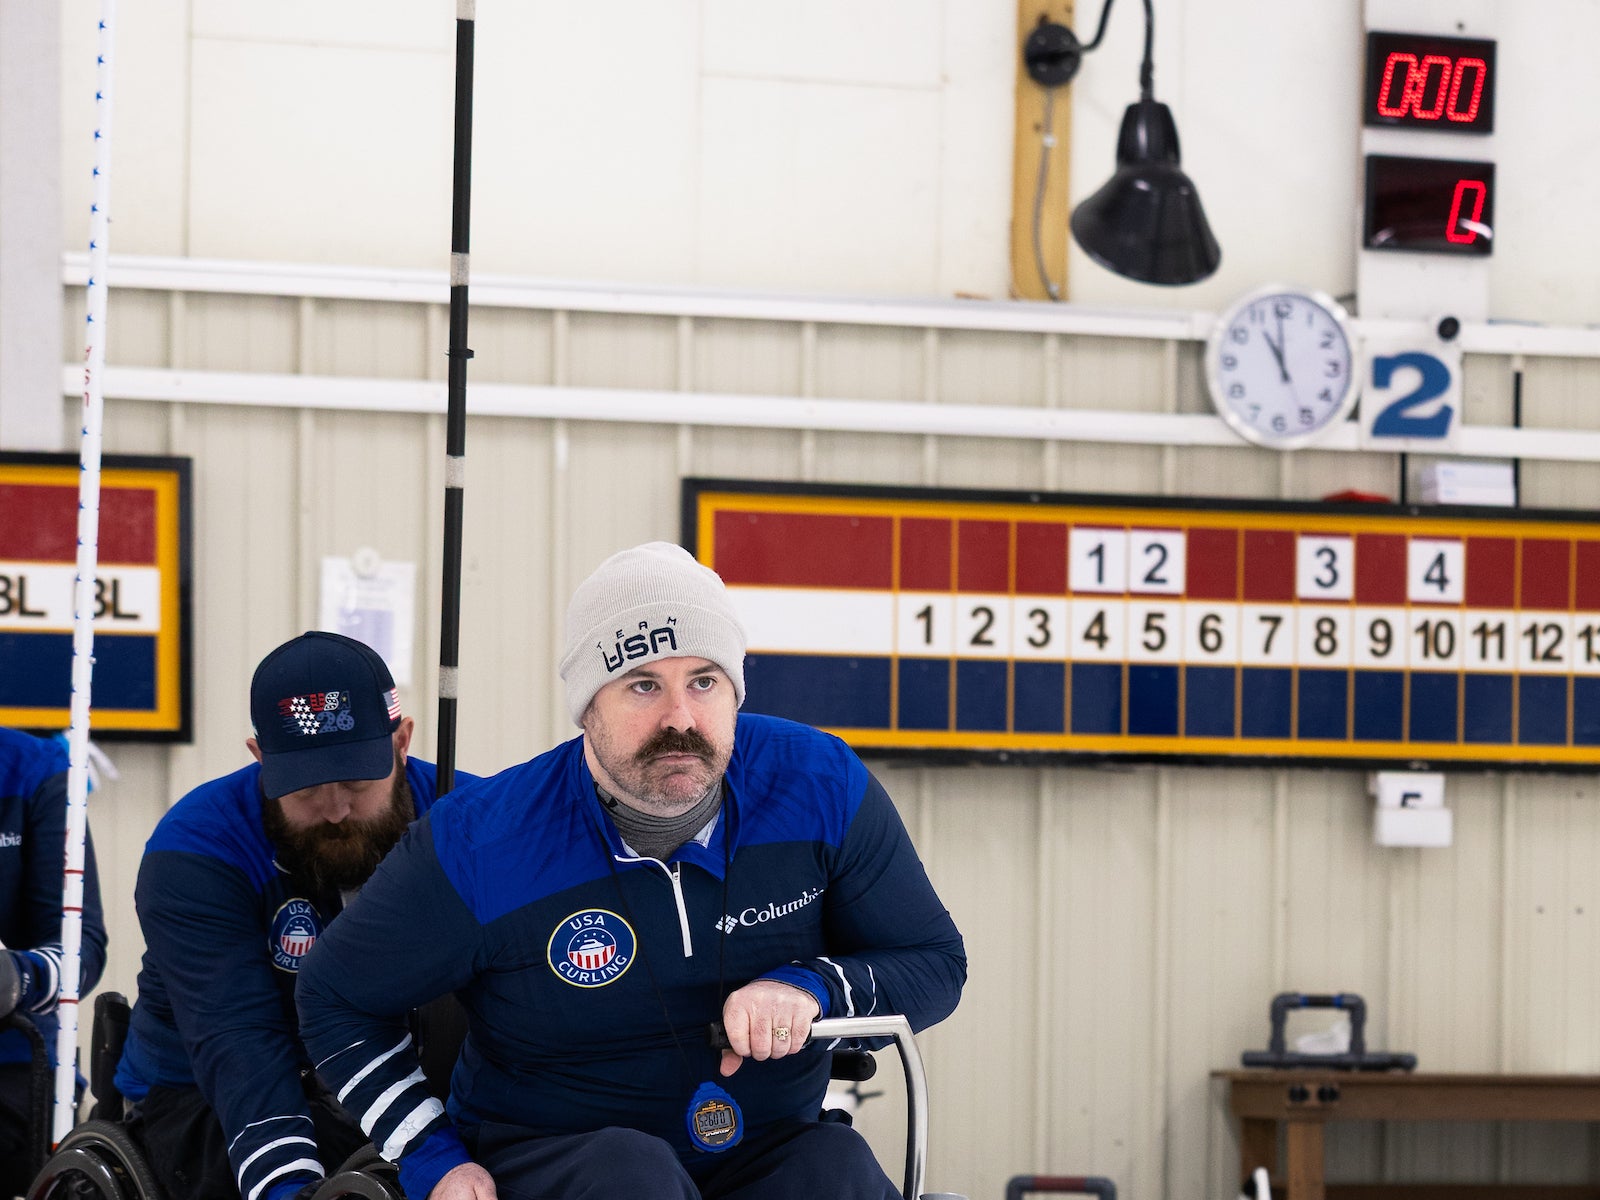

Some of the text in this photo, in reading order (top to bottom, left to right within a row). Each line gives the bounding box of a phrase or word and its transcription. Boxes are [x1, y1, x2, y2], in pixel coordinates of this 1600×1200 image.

[1445, 179, 1487, 244] 0
[1372, 352, 1454, 439] 2
[1087, 543, 1450, 593] 1 2 3 4
[597, 616, 677, 650] TEAM
[602, 627, 678, 673] USA
[915, 605, 1600, 664] 1 2 3 4 5 6 7 8 9 10 11 12 1
[316, 709, 355, 733] 26
[288, 903, 312, 916] USA
[569, 915, 605, 930] USA
[558, 954, 628, 983] CURLING
